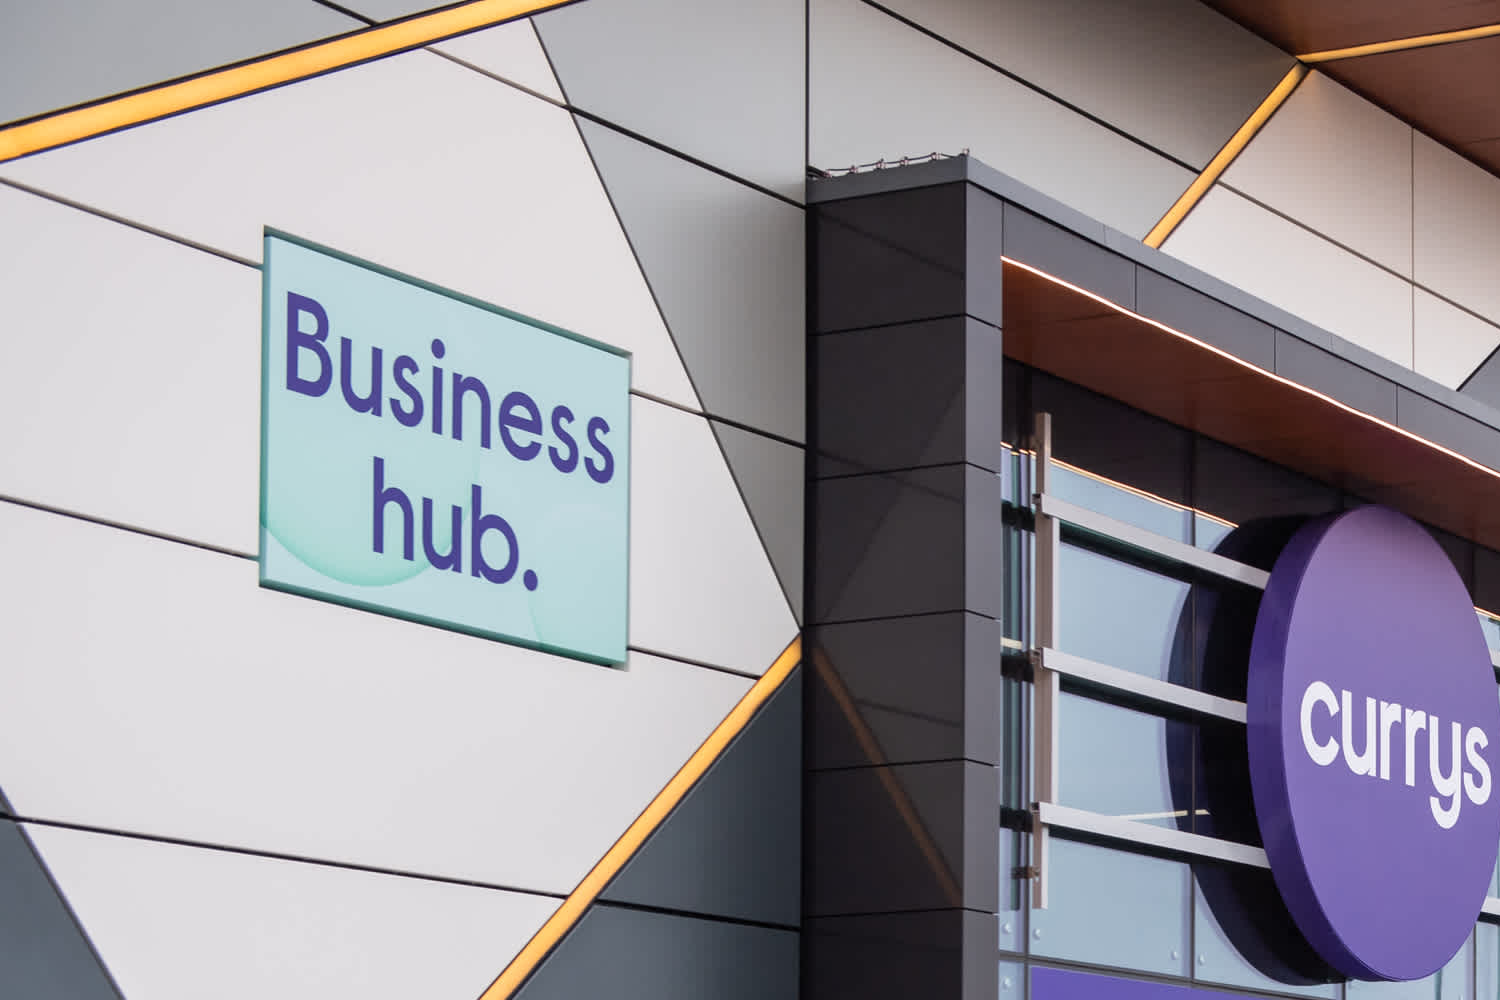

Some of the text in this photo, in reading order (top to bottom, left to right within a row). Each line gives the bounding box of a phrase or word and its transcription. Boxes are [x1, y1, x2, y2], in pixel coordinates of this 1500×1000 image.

[286, 291, 614, 484] Business
[373, 456, 538, 591] hub.
[1301, 681, 1492, 829] currys
